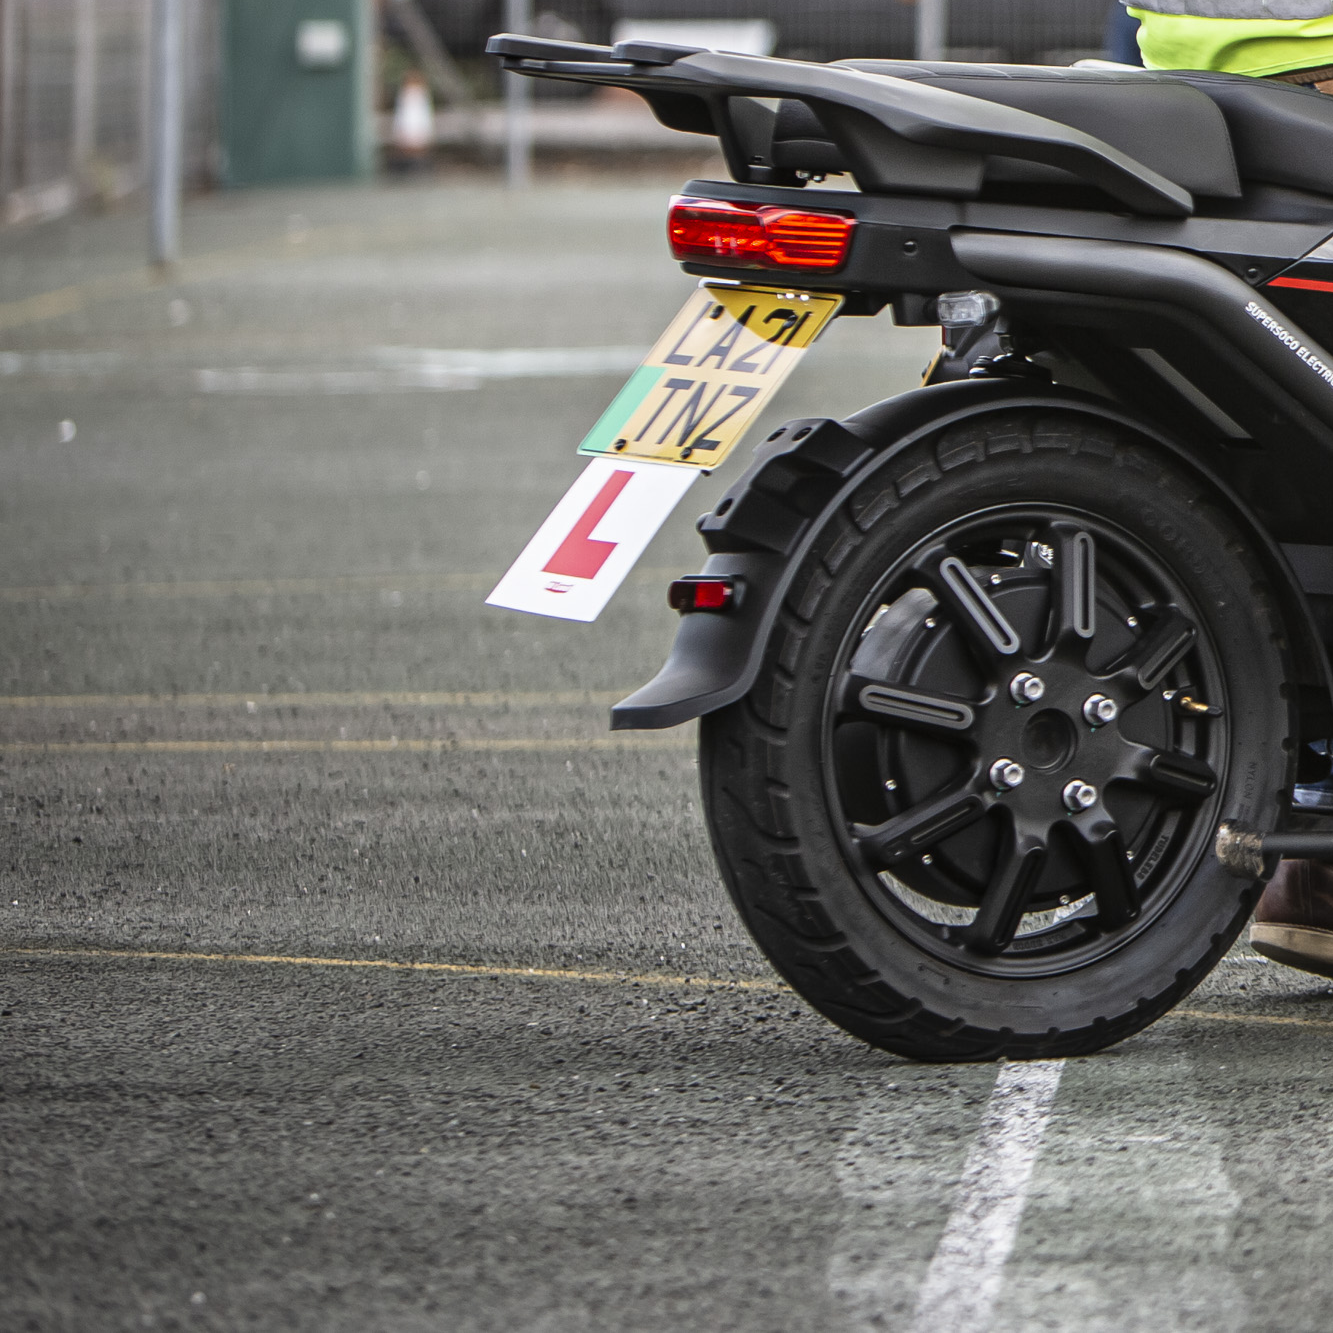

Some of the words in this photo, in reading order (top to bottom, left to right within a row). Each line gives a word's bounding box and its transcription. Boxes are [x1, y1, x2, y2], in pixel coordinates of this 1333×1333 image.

[661, 300, 813, 375] LA21
[1245, 301, 1300, 351] SUPERSOCO
[633, 377, 762, 451] TNZ
[541, 469, 636, 580] L
